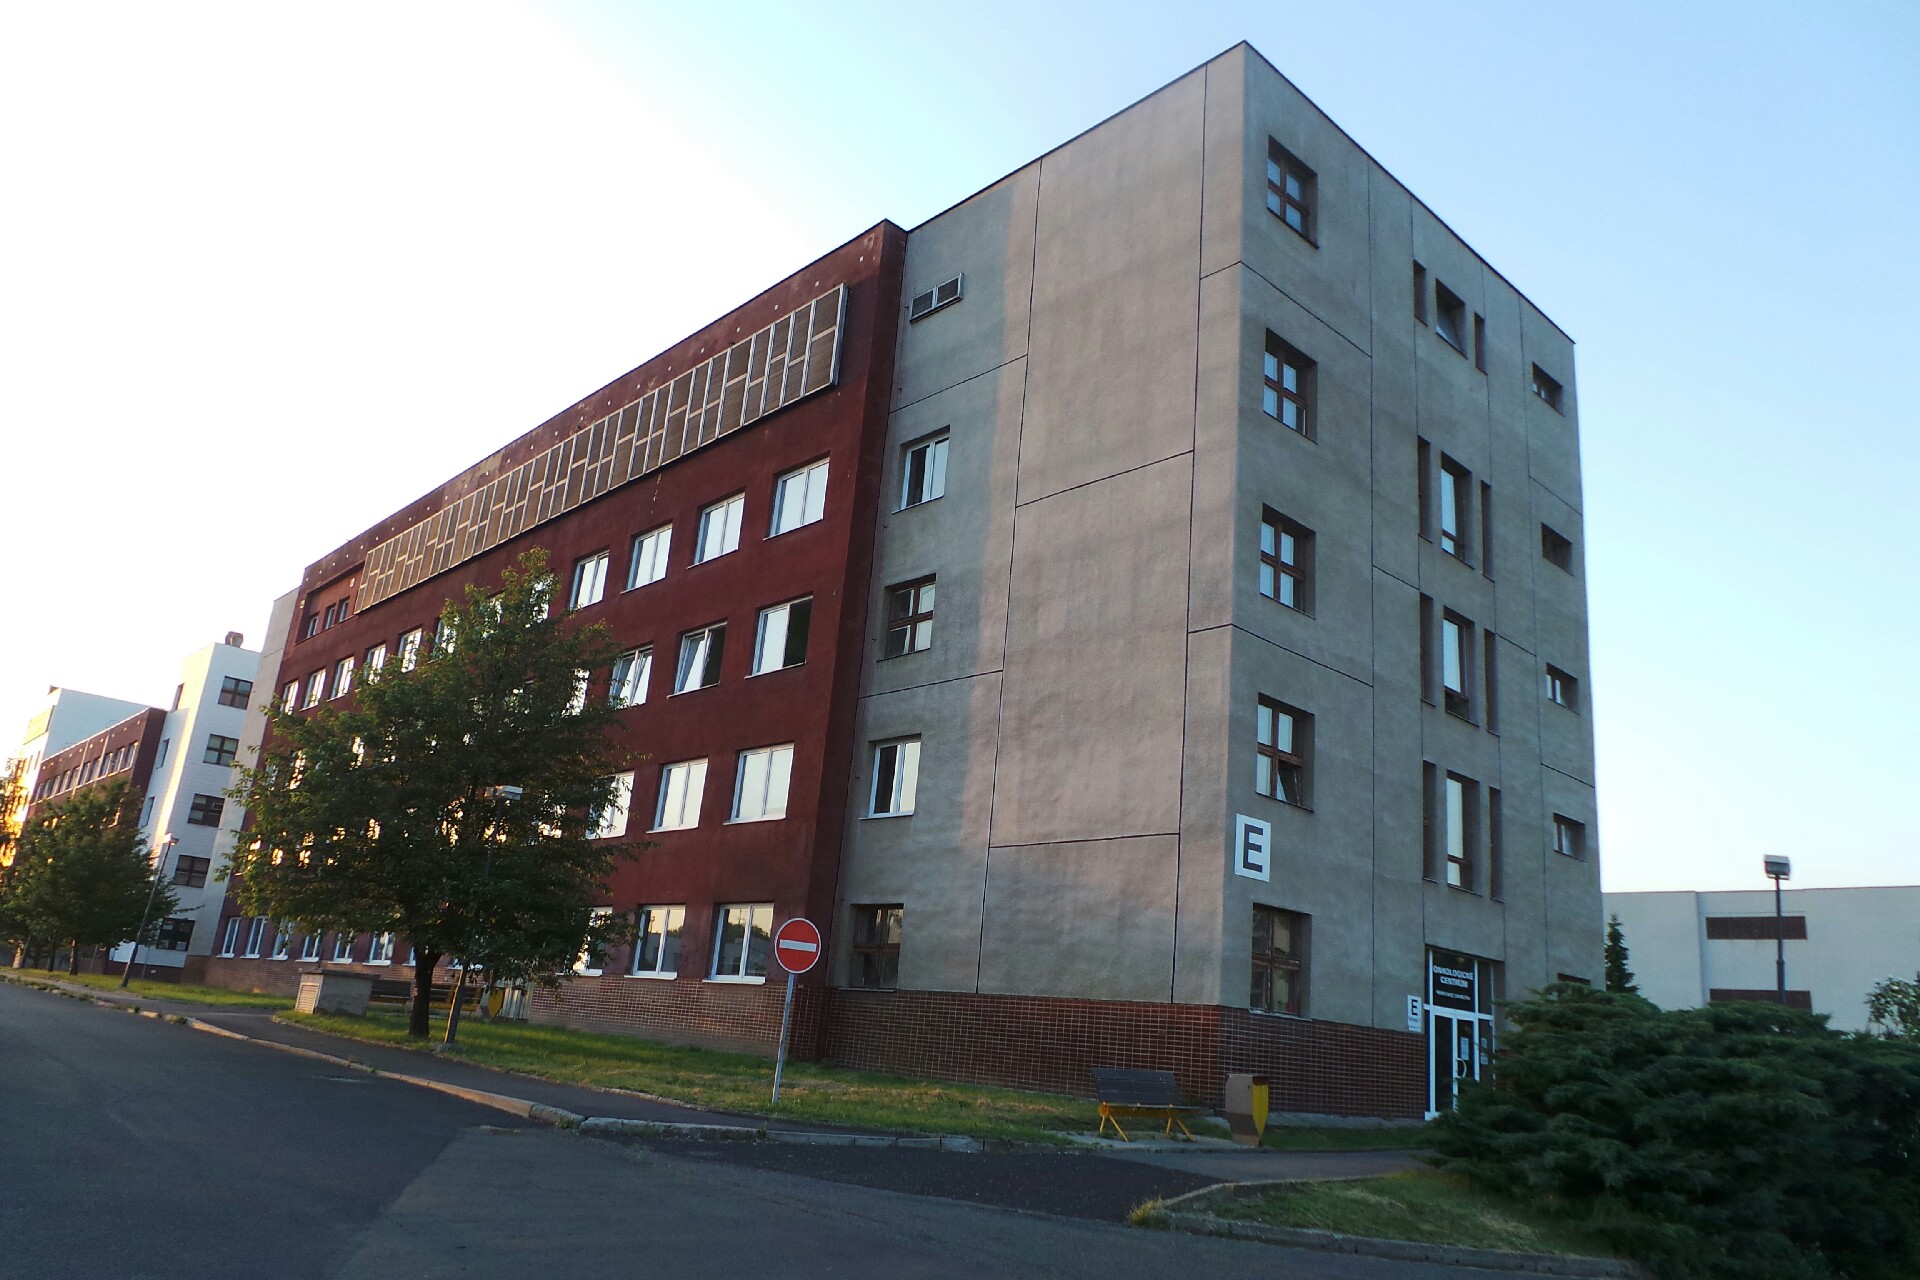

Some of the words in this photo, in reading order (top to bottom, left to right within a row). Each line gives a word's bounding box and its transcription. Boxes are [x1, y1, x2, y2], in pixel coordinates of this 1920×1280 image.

[1243, 824, 1263, 873] E
[1440, 976, 1468, 988] CENTRUM
[1411, 999, 1418, 1016] E
